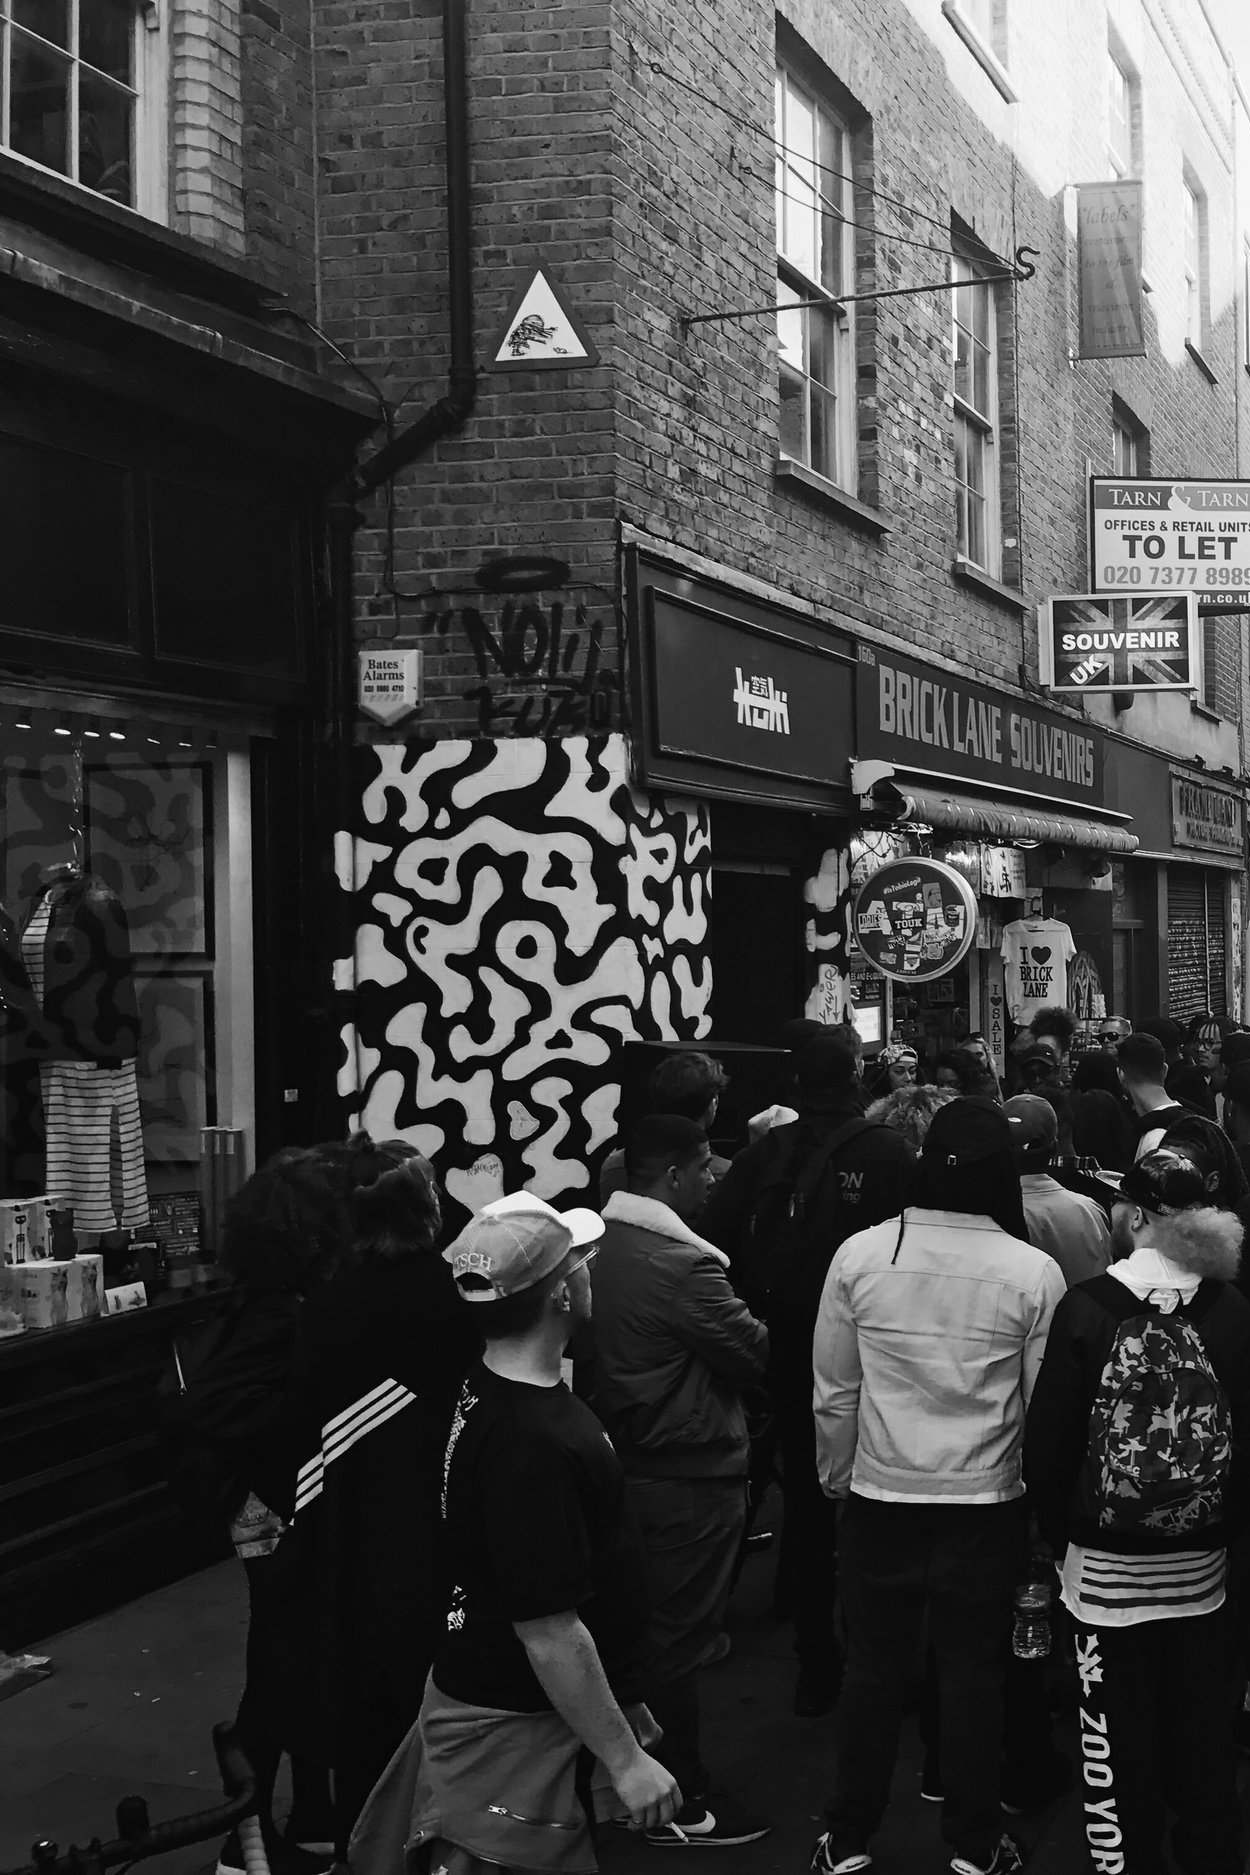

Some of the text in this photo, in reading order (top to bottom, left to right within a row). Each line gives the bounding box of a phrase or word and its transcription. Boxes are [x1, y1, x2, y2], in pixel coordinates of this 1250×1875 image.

[1109, 489, 1162, 507] TARN
[1197, 490, 1249, 507] TARN
[1104, 519, 1156, 532] OFFICES
[1159, 521, 1168, 532] &
[1172, 521, 1215, 533] RETAIL
[1122, 534, 1238, 560] TO LET
[1103, 565, 1142, 585] 020
[1149, 566, 1198, 585] 7377
[1062, 631, 1180, 651] SOUVENIR
[368, 658, 399, 670] Bates
[1069, 653, 1103, 686] UK
[363, 670, 405, 681] Alarms
[879, 664, 1095, 788] BRICK LANE SOUVENIRS
[1019, 946, 1029, 965] I
[1019, 966, 1053, 982] BRICK
[992, 984, 1000, 995] I
[1023, 982, 1049, 998] LANE
[991, 1008, 1002, 1055] SALE
[1079, 1706, 1114, 1788] ZOO
